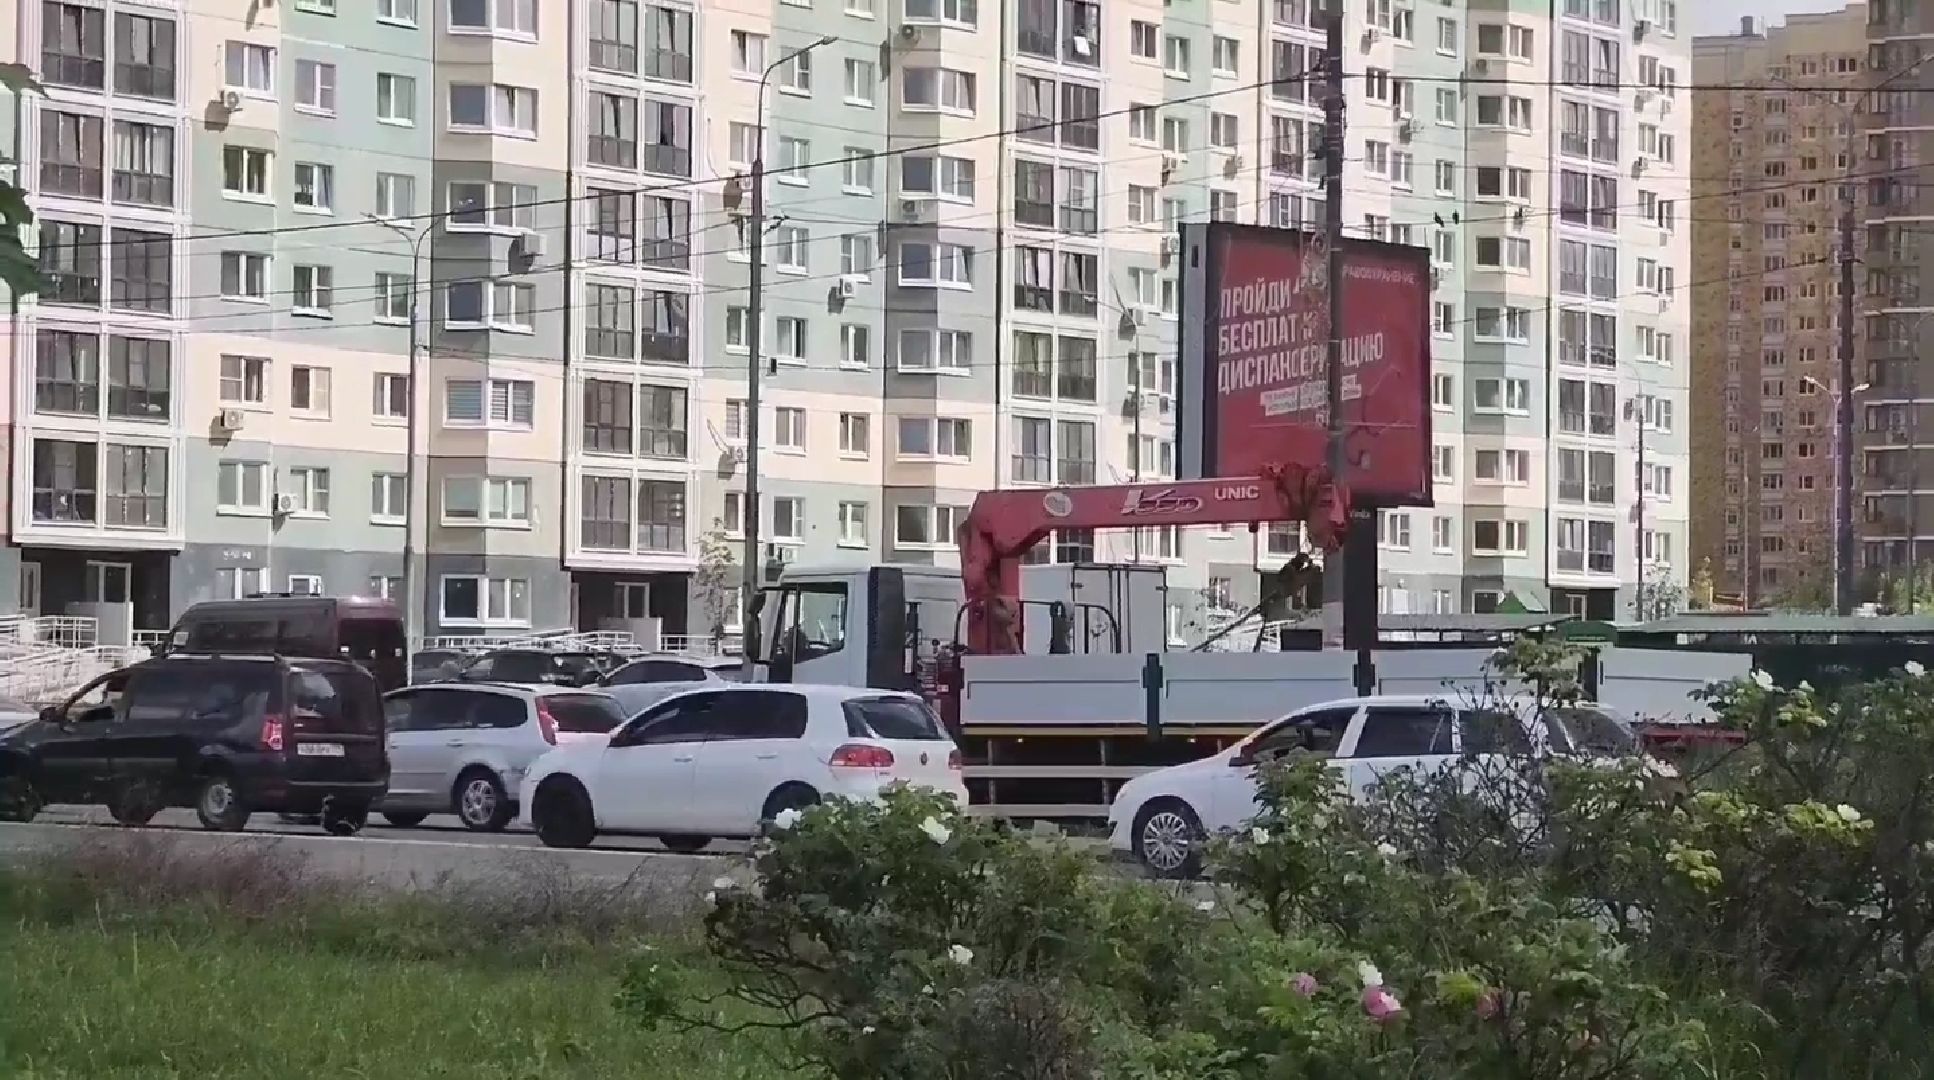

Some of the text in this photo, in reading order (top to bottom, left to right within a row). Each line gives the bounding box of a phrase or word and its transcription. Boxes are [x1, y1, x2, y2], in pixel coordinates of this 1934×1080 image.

[1220, 278, 1291, 318] ПРОЙДИ
[1218, 312, 1314, 356] БЕСПЛАТ
[1218, 333, 1384, 395] ДИСПАНСЕРИАЦИЮ
[1214, 485, 1260, 501] UNIC
